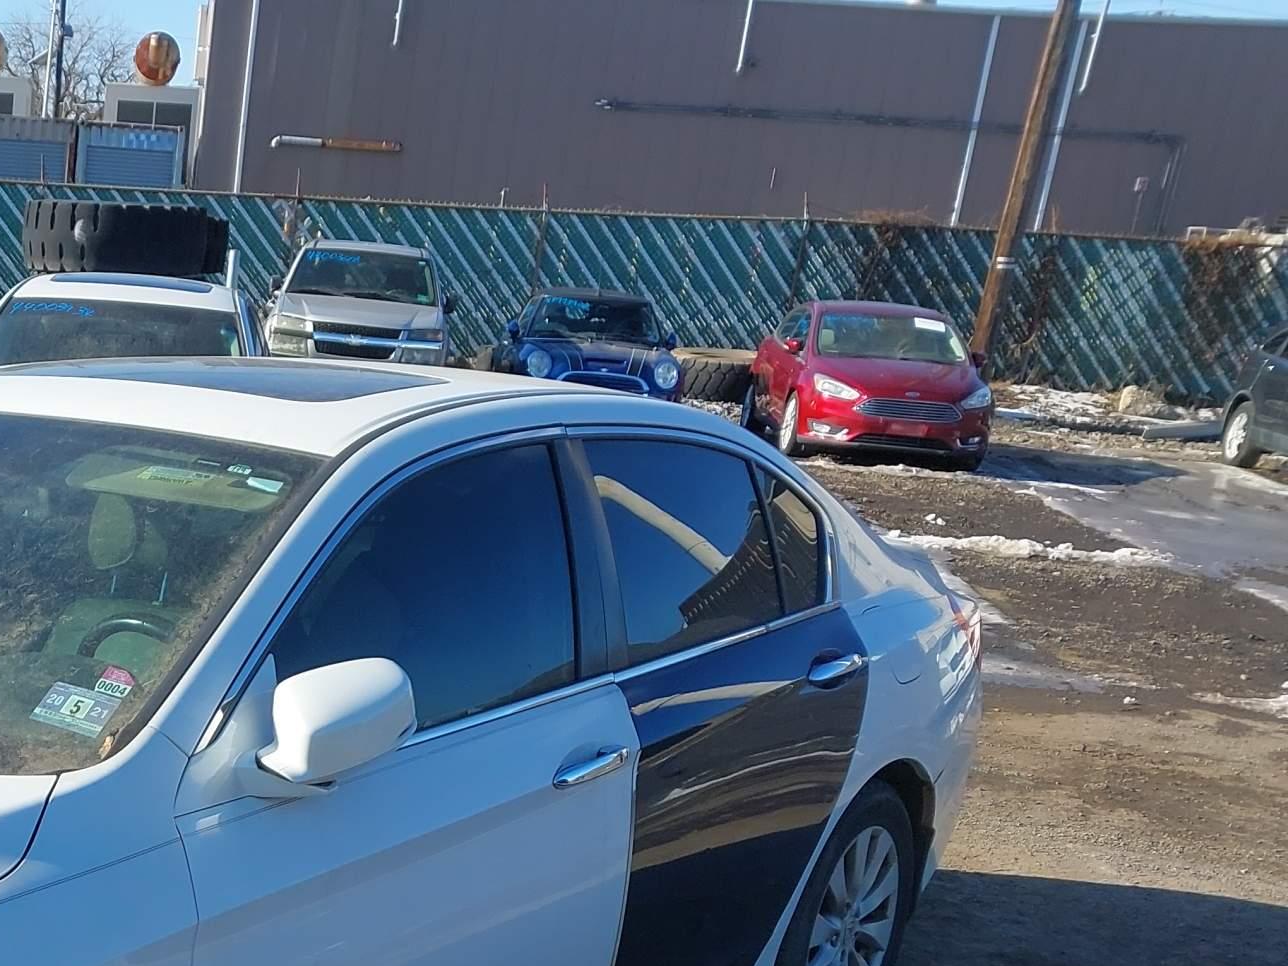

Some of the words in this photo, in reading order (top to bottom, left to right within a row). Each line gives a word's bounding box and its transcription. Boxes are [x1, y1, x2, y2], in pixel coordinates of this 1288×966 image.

[97, 680, 128, 695] 0004
[46, 694, 64, 706] 20
[69, 699, 85, 714] 5
[90, 707, 109, 719] 21
